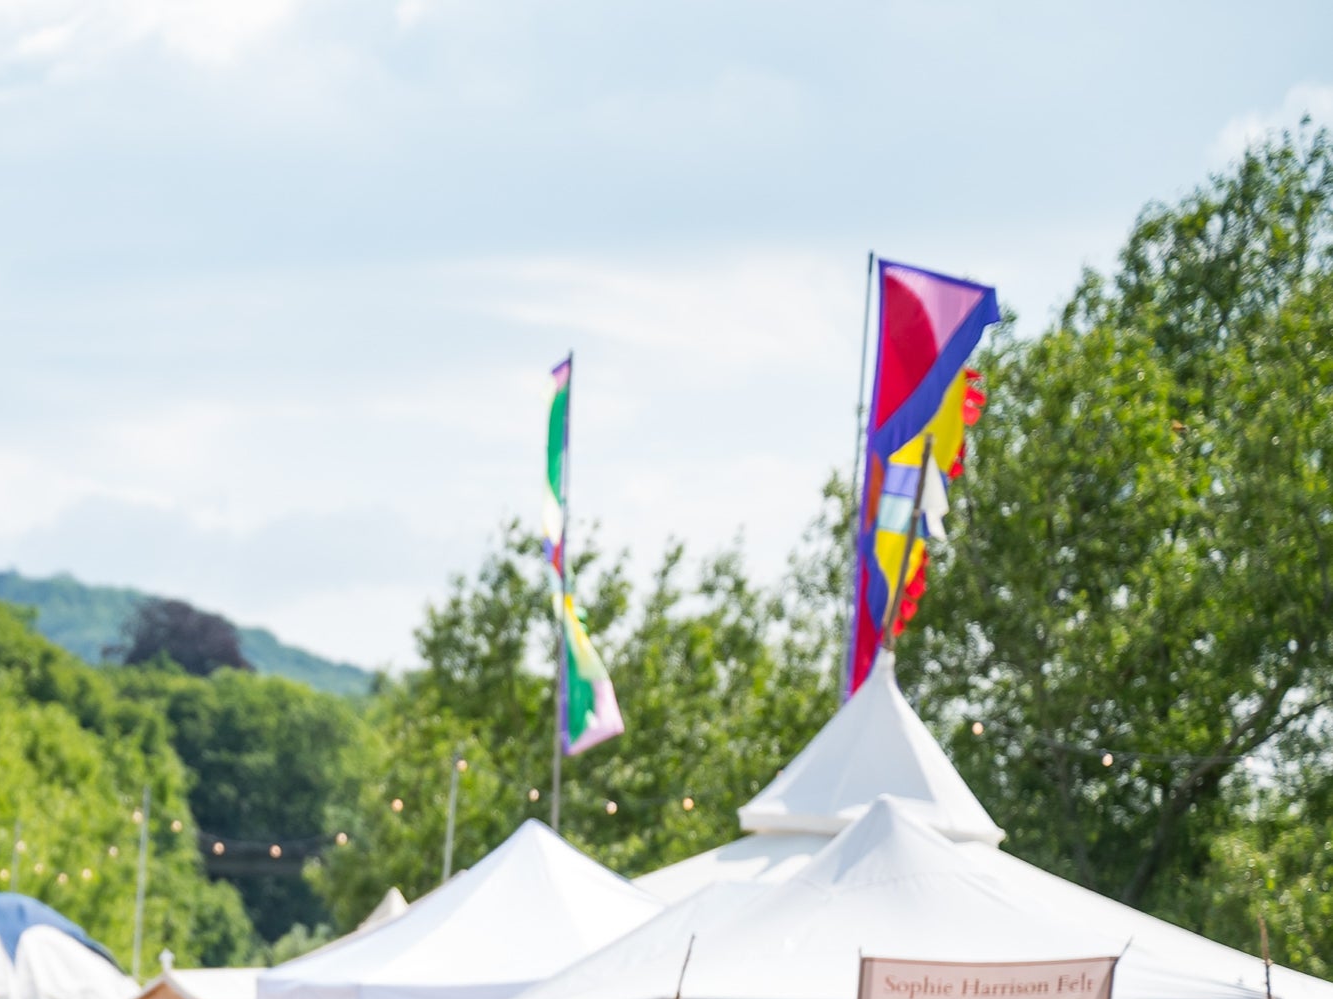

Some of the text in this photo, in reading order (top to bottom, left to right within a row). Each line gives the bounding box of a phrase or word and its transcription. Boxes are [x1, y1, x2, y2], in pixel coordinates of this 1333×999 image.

[884, 972, 1093, 999] Sophie Harrison Felt
